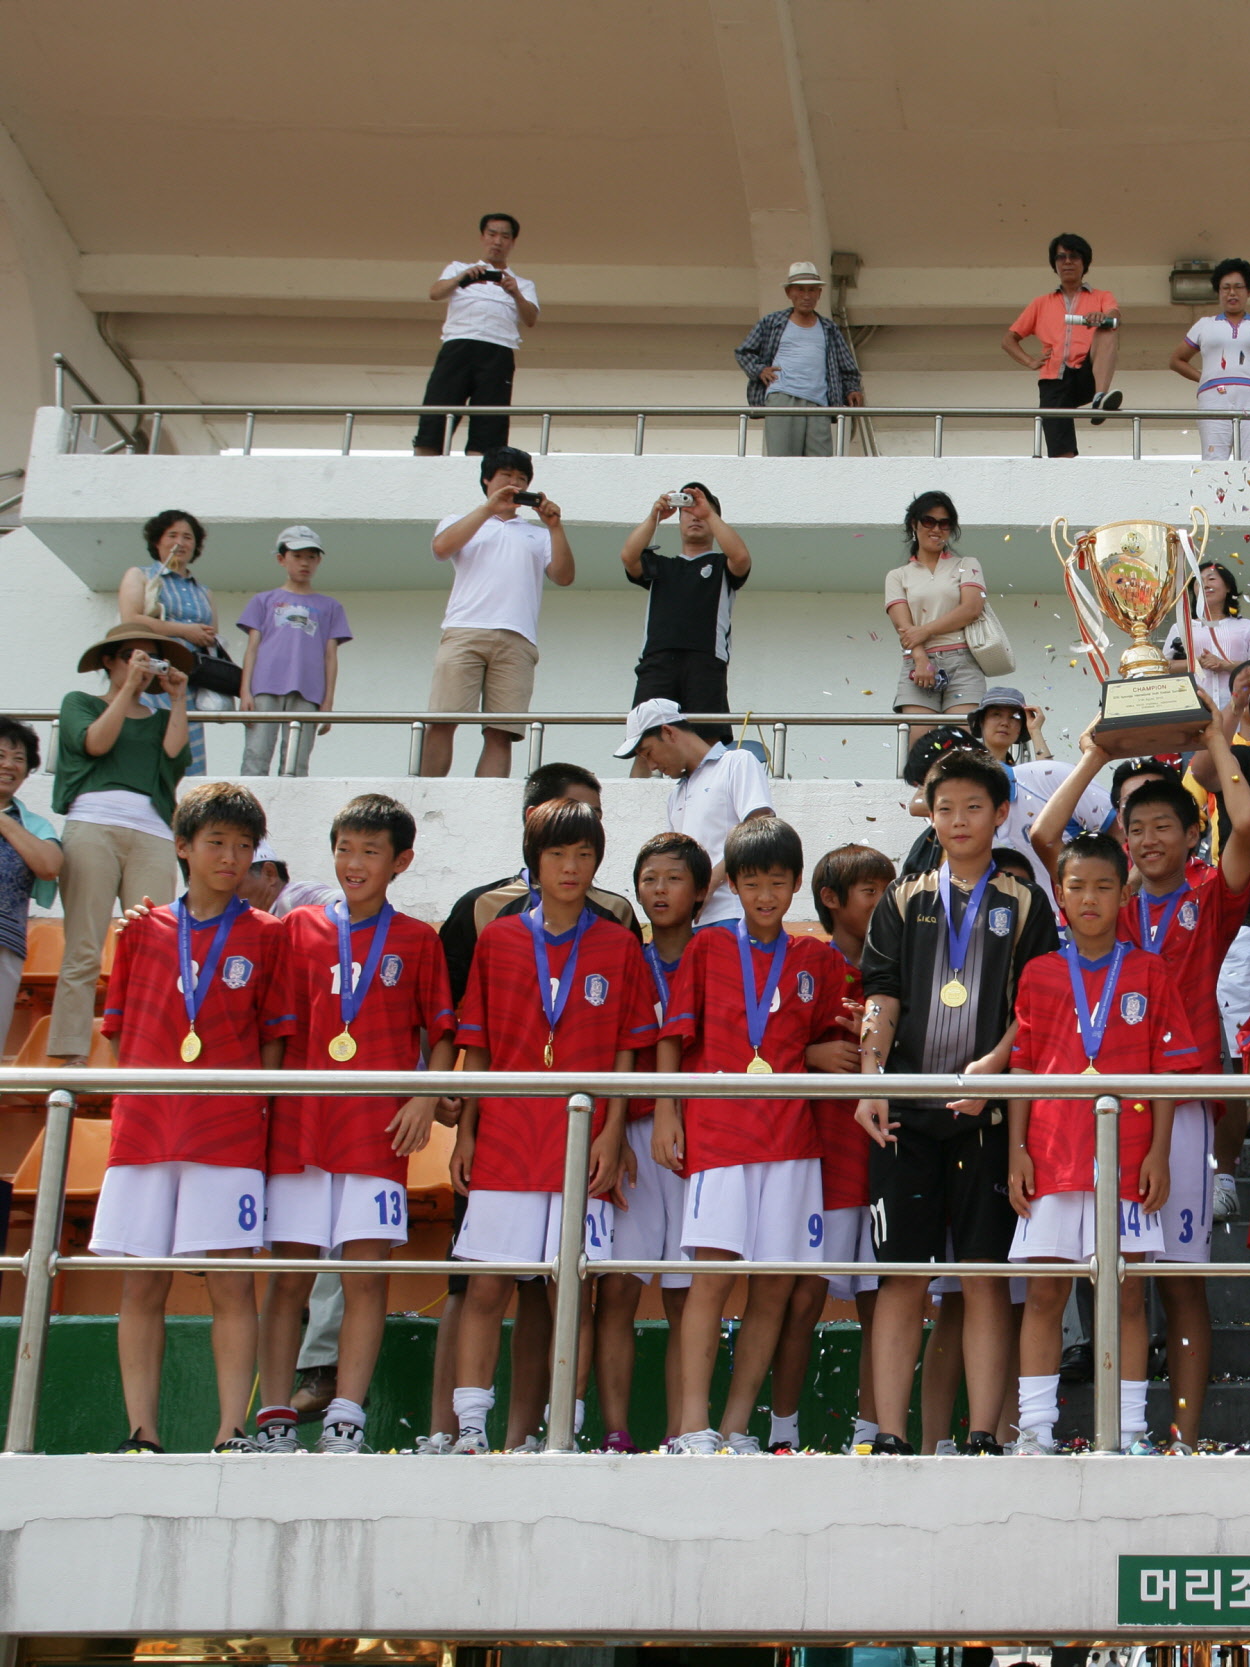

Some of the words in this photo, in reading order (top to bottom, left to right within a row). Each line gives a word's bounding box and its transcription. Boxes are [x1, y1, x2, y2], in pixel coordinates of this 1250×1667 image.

[1133, 684, 1167, 693] CHAMPION
[238, 1193, 257, 1231] 8
[374, 1190, 402, 1226] 13
[1178, 1208, 1194, 1244] 3
[807, 1213, 824, 1248] 9
